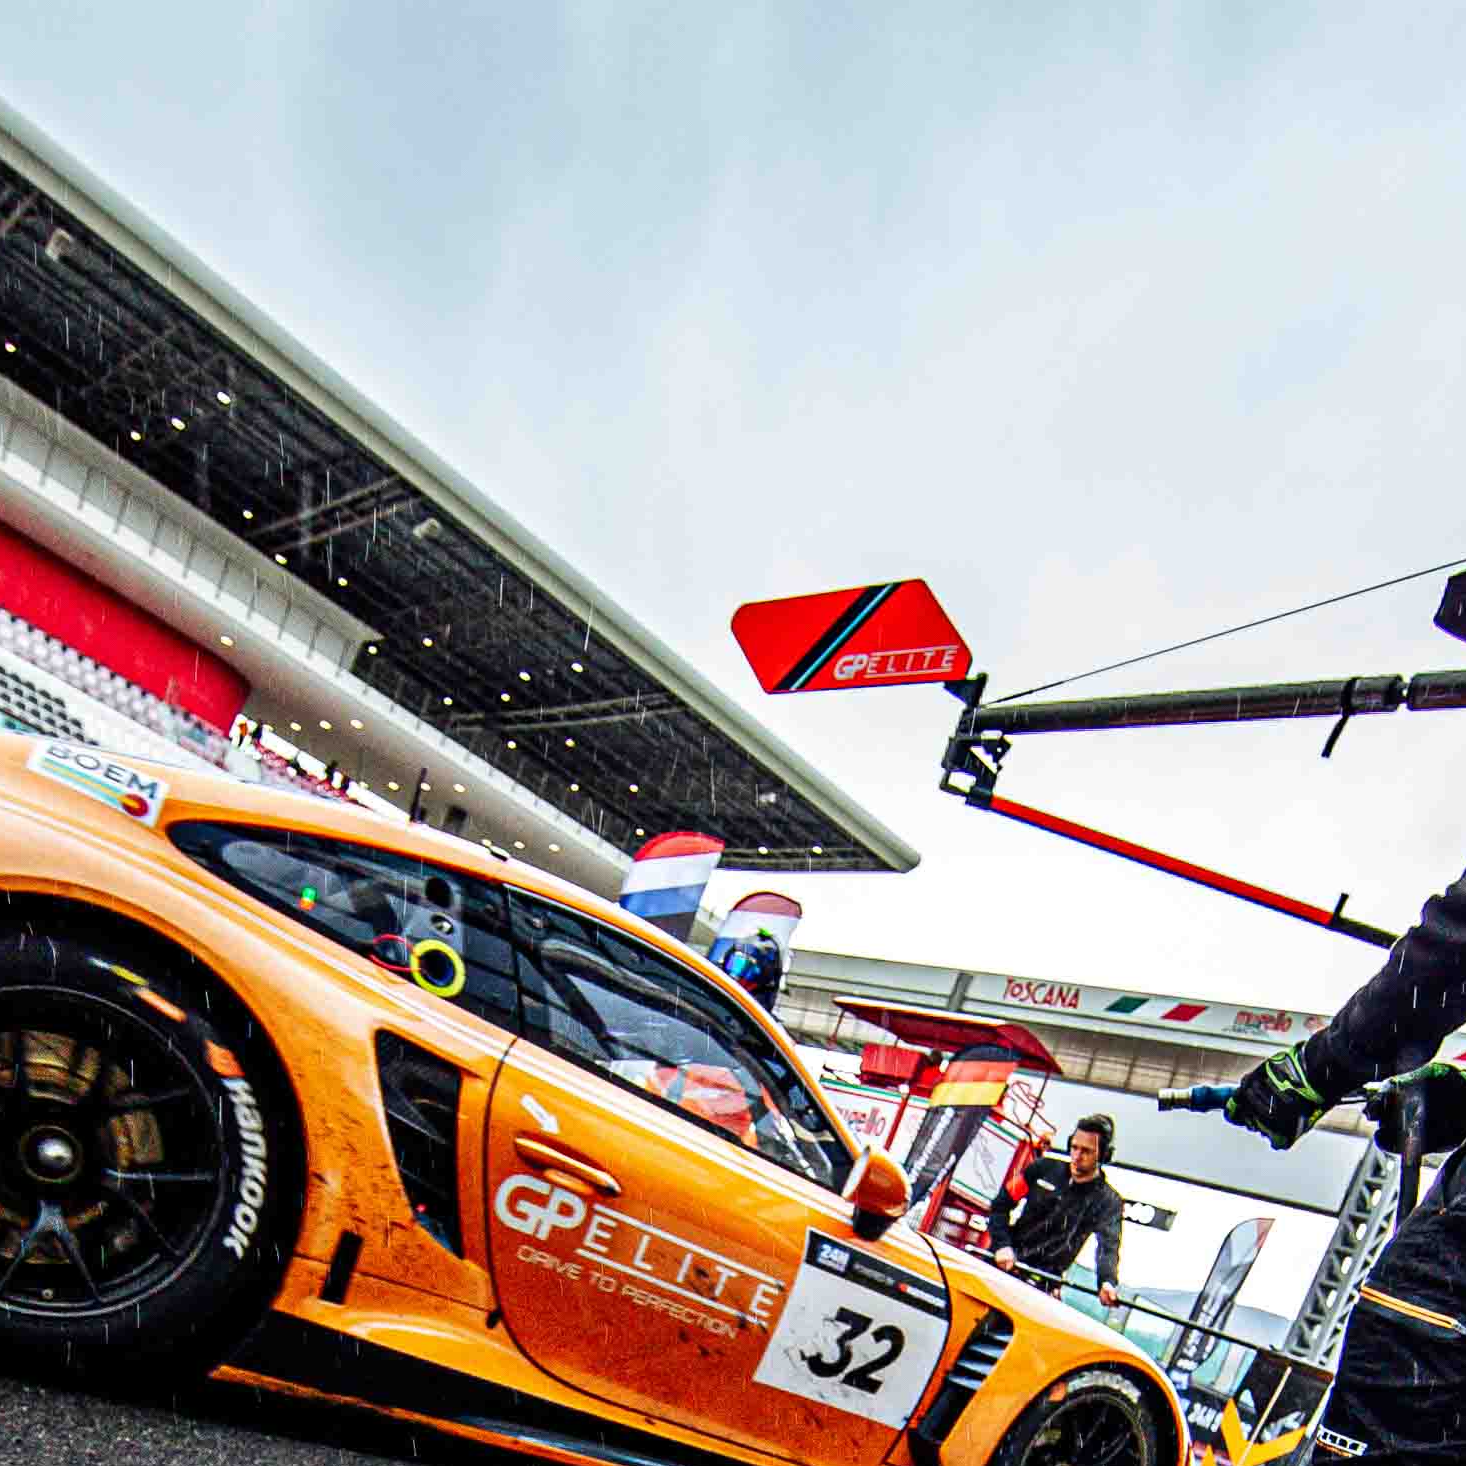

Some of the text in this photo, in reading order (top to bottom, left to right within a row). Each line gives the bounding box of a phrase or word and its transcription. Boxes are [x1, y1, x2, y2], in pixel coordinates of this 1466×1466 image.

[47, 745, 158, 799] BOEM
[516, 1244, 738, 1339] DRIVE TO PERFECTION
[583, 1213, 782, 1319] ELITE
[799, 1306, 906, 1395] 32
